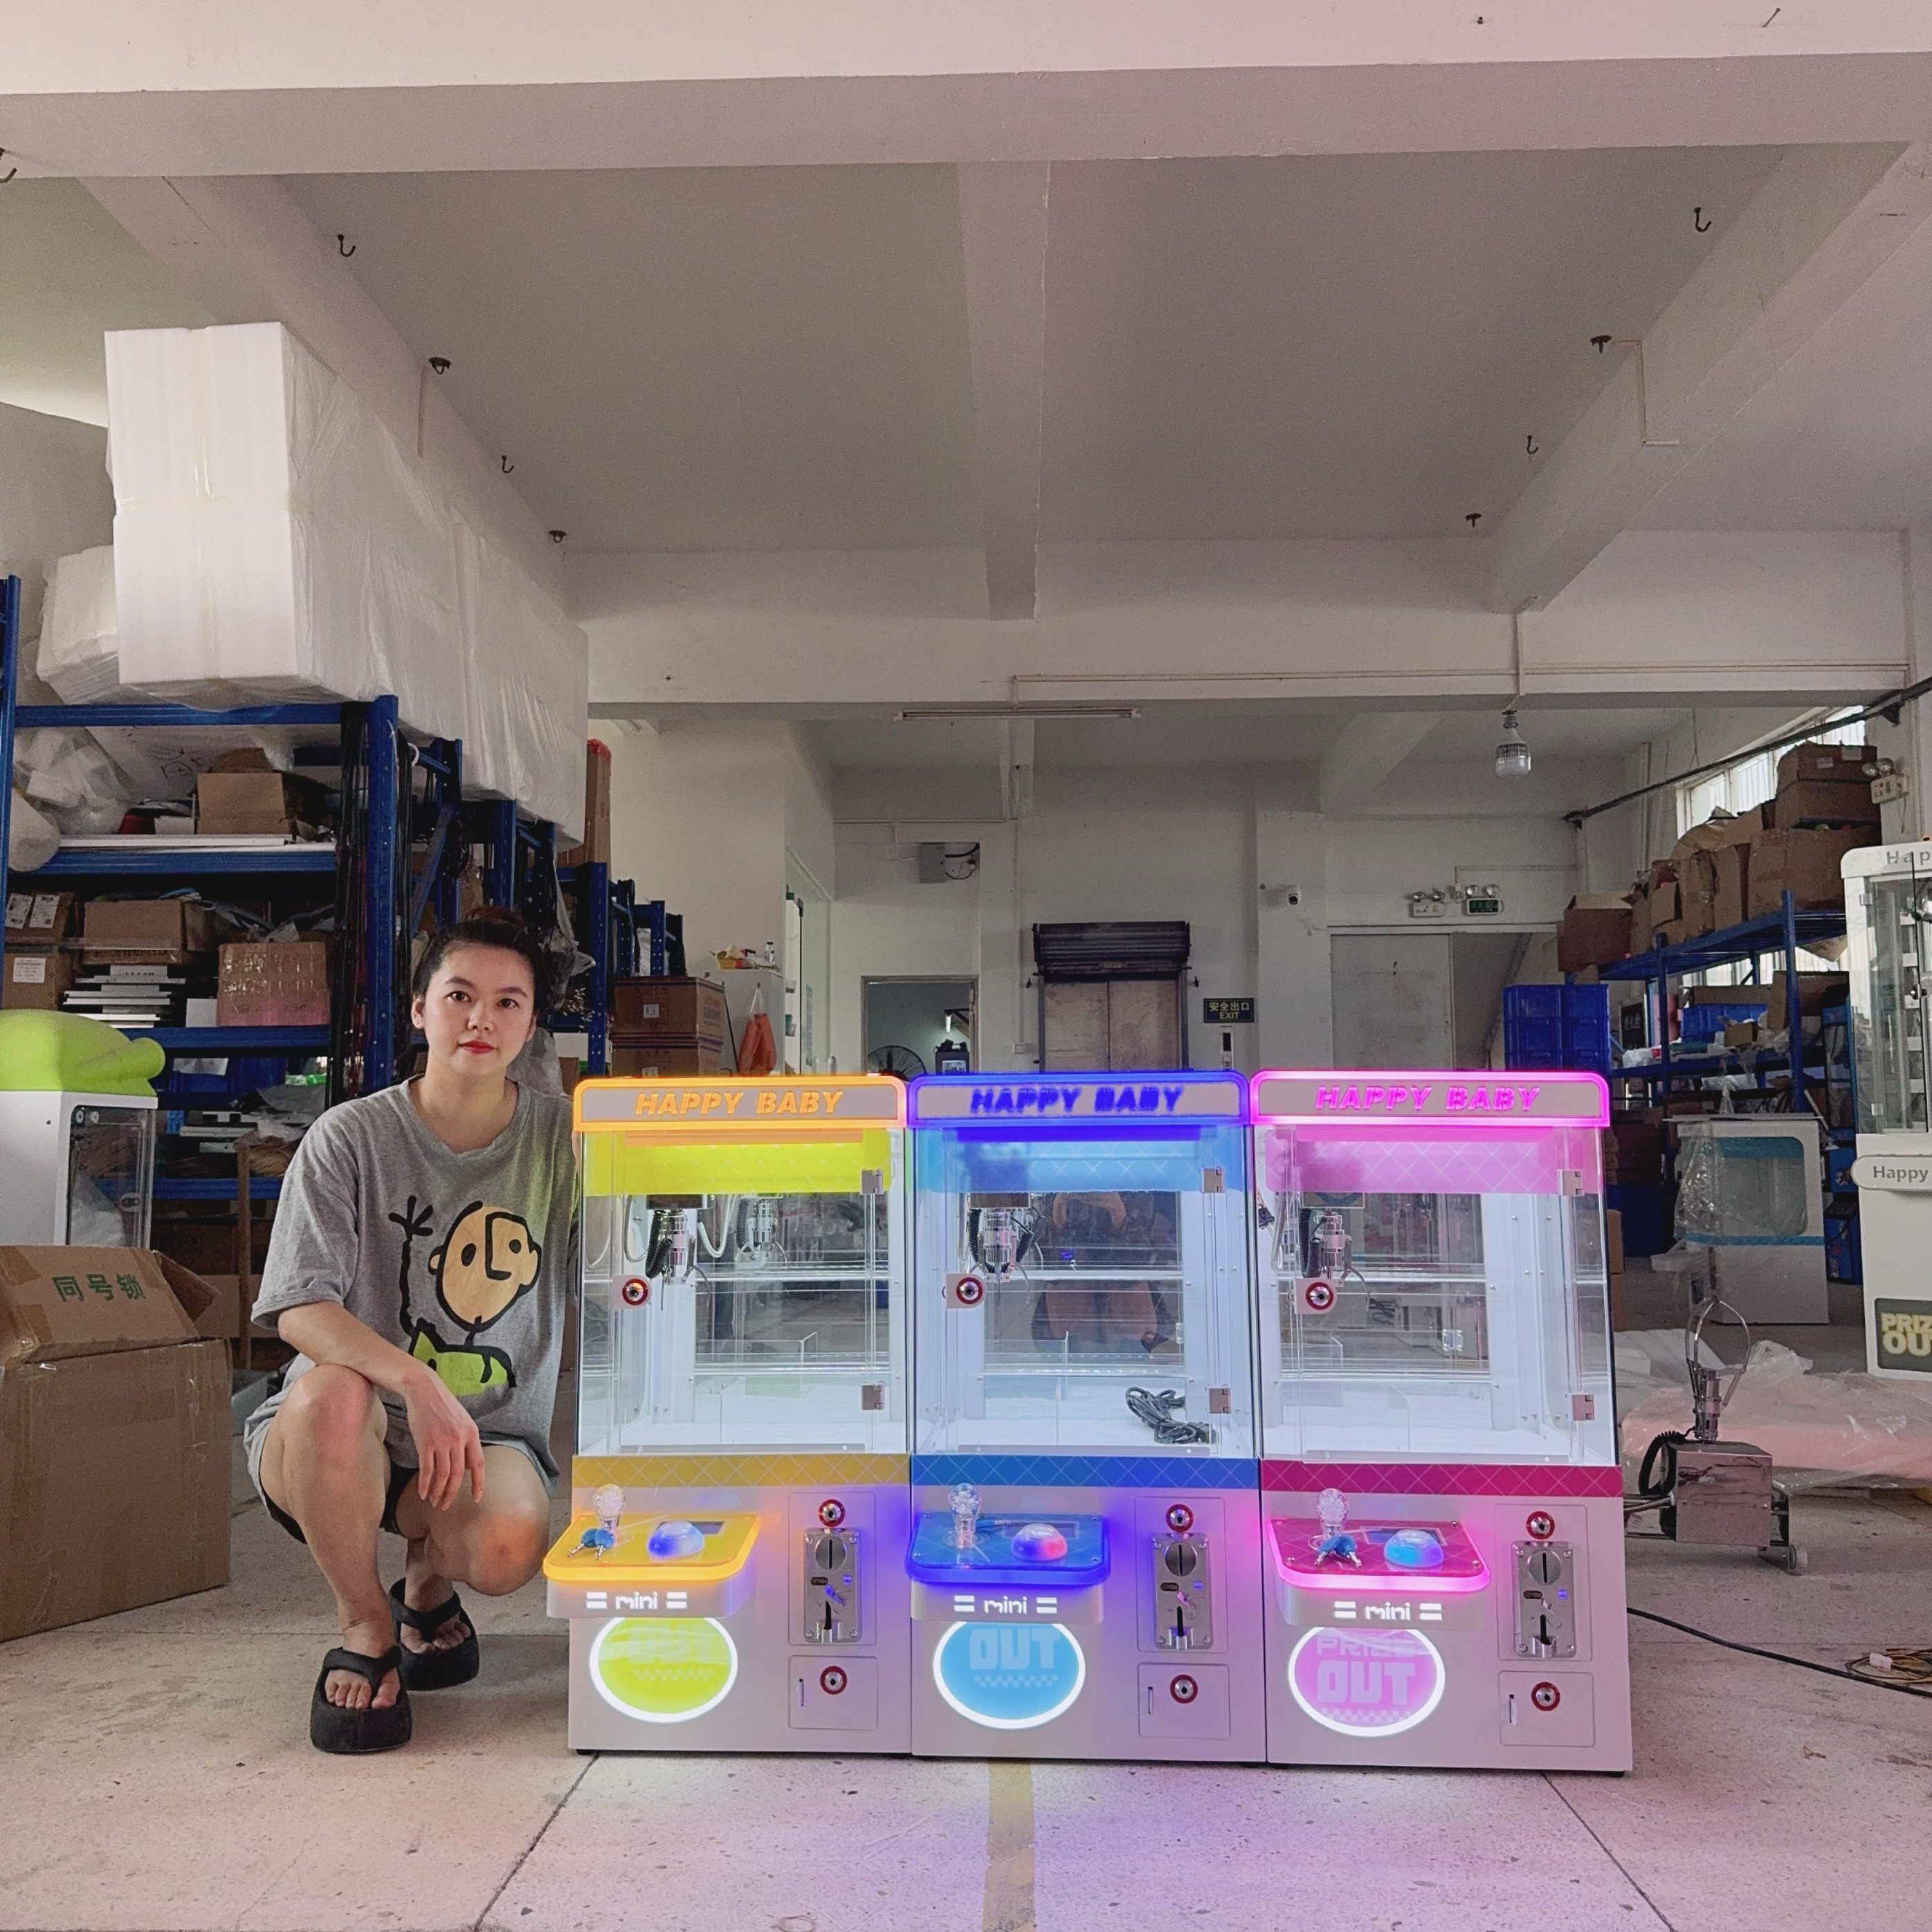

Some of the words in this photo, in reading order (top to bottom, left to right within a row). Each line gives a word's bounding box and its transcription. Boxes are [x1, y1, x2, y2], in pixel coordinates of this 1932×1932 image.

[1209, 1001, 1249, 1012] 安全出口
[1219, 1011, 1239, 1019] EXIT
[635, 1092, 745, 1115] HAPPY
[756, 1091, 844, 1113] BABY
[970, 1087, 1082, 1113] HAPPY
[1093, 1086, 1185, 1112] BABY
[1315, 1086, 1432, 1110] HAPPY
[1446, 1086, 1541, 1111] BABY
[1872, 1165, 1929, 1183] Happy
[51, 1273, 147, 1303] 同号锁
[1882, 1330, 1932, 1357] OU
[614, 1591, 658, 1611] mini
[983, 1596, 1028, 1614] mini
[1365, 1601, 1411, 1621] mini
[969, 1628, 1061, 1670] OUT
[1317, 1659, 1415, 1706] OUT
